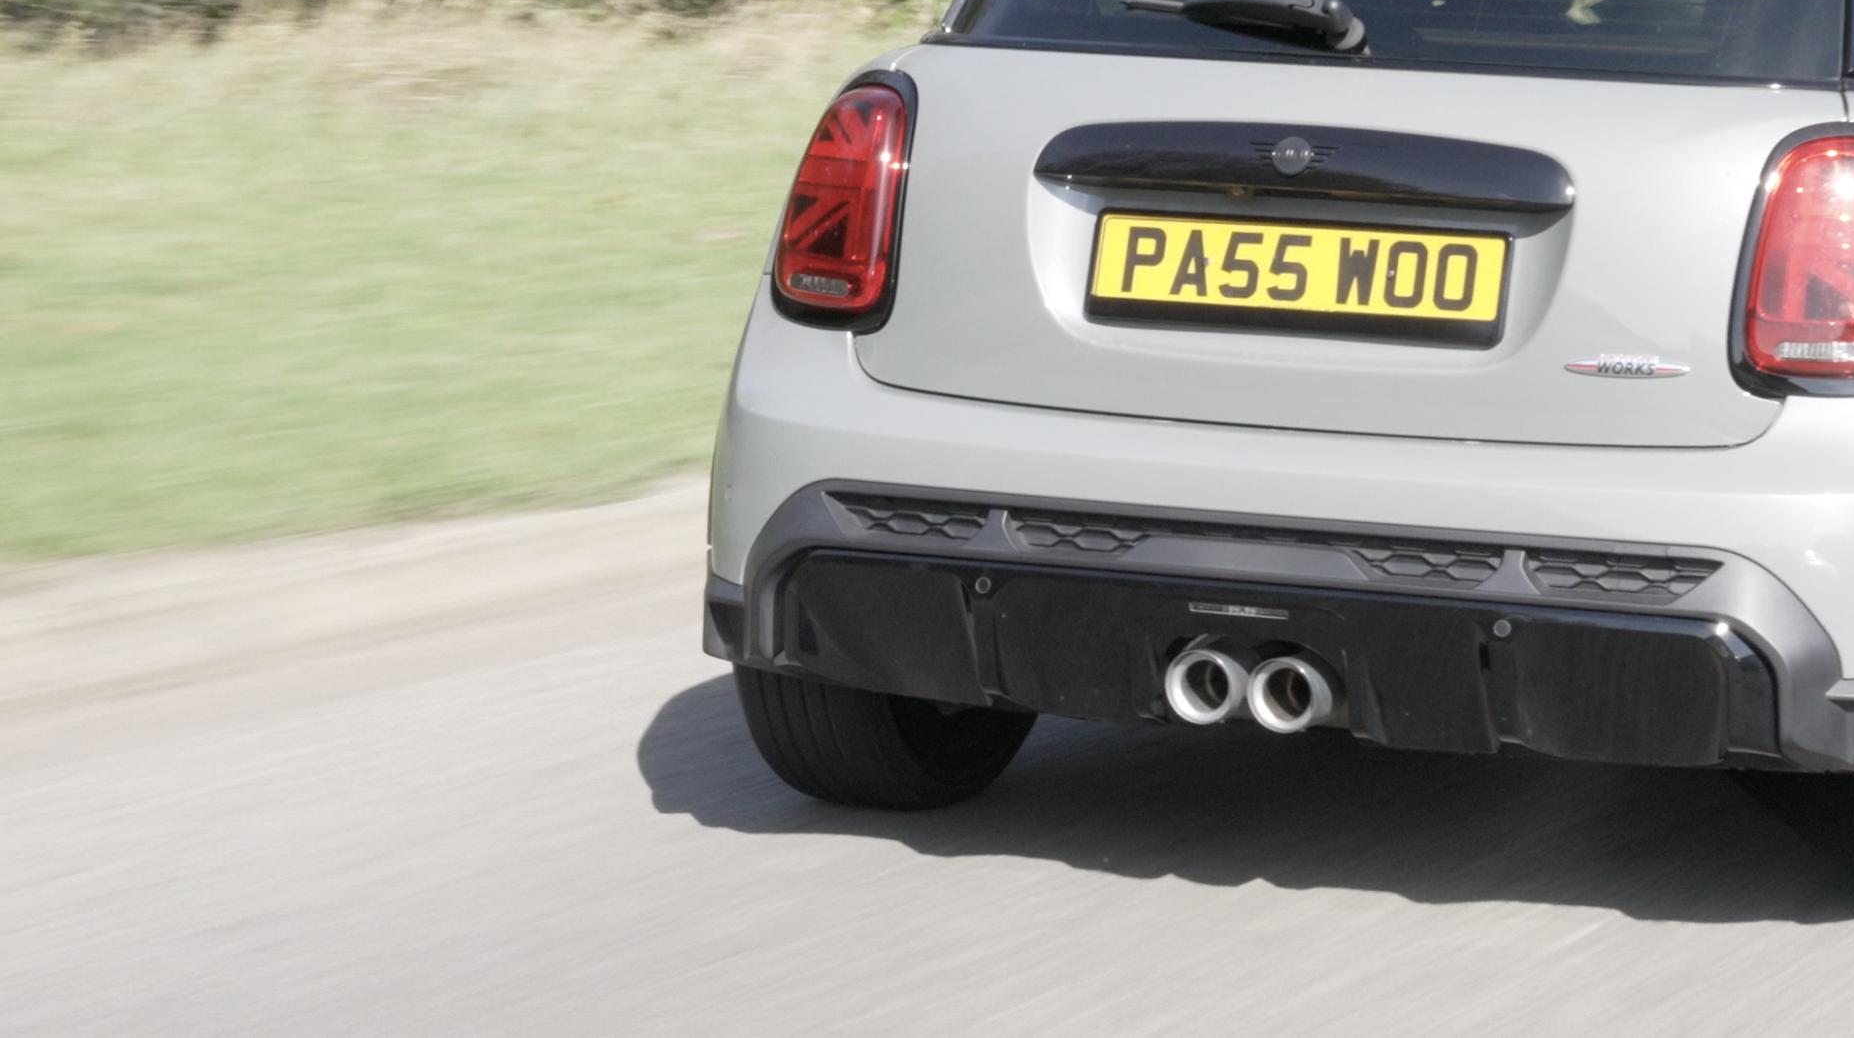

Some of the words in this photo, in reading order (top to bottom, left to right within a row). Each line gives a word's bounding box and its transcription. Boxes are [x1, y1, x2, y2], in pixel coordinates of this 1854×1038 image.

[1121, 226, 1313, 301] PA55
[1336, 237, 1478, 311] WOO
[1597, 361, 1655, 375] WORKS
